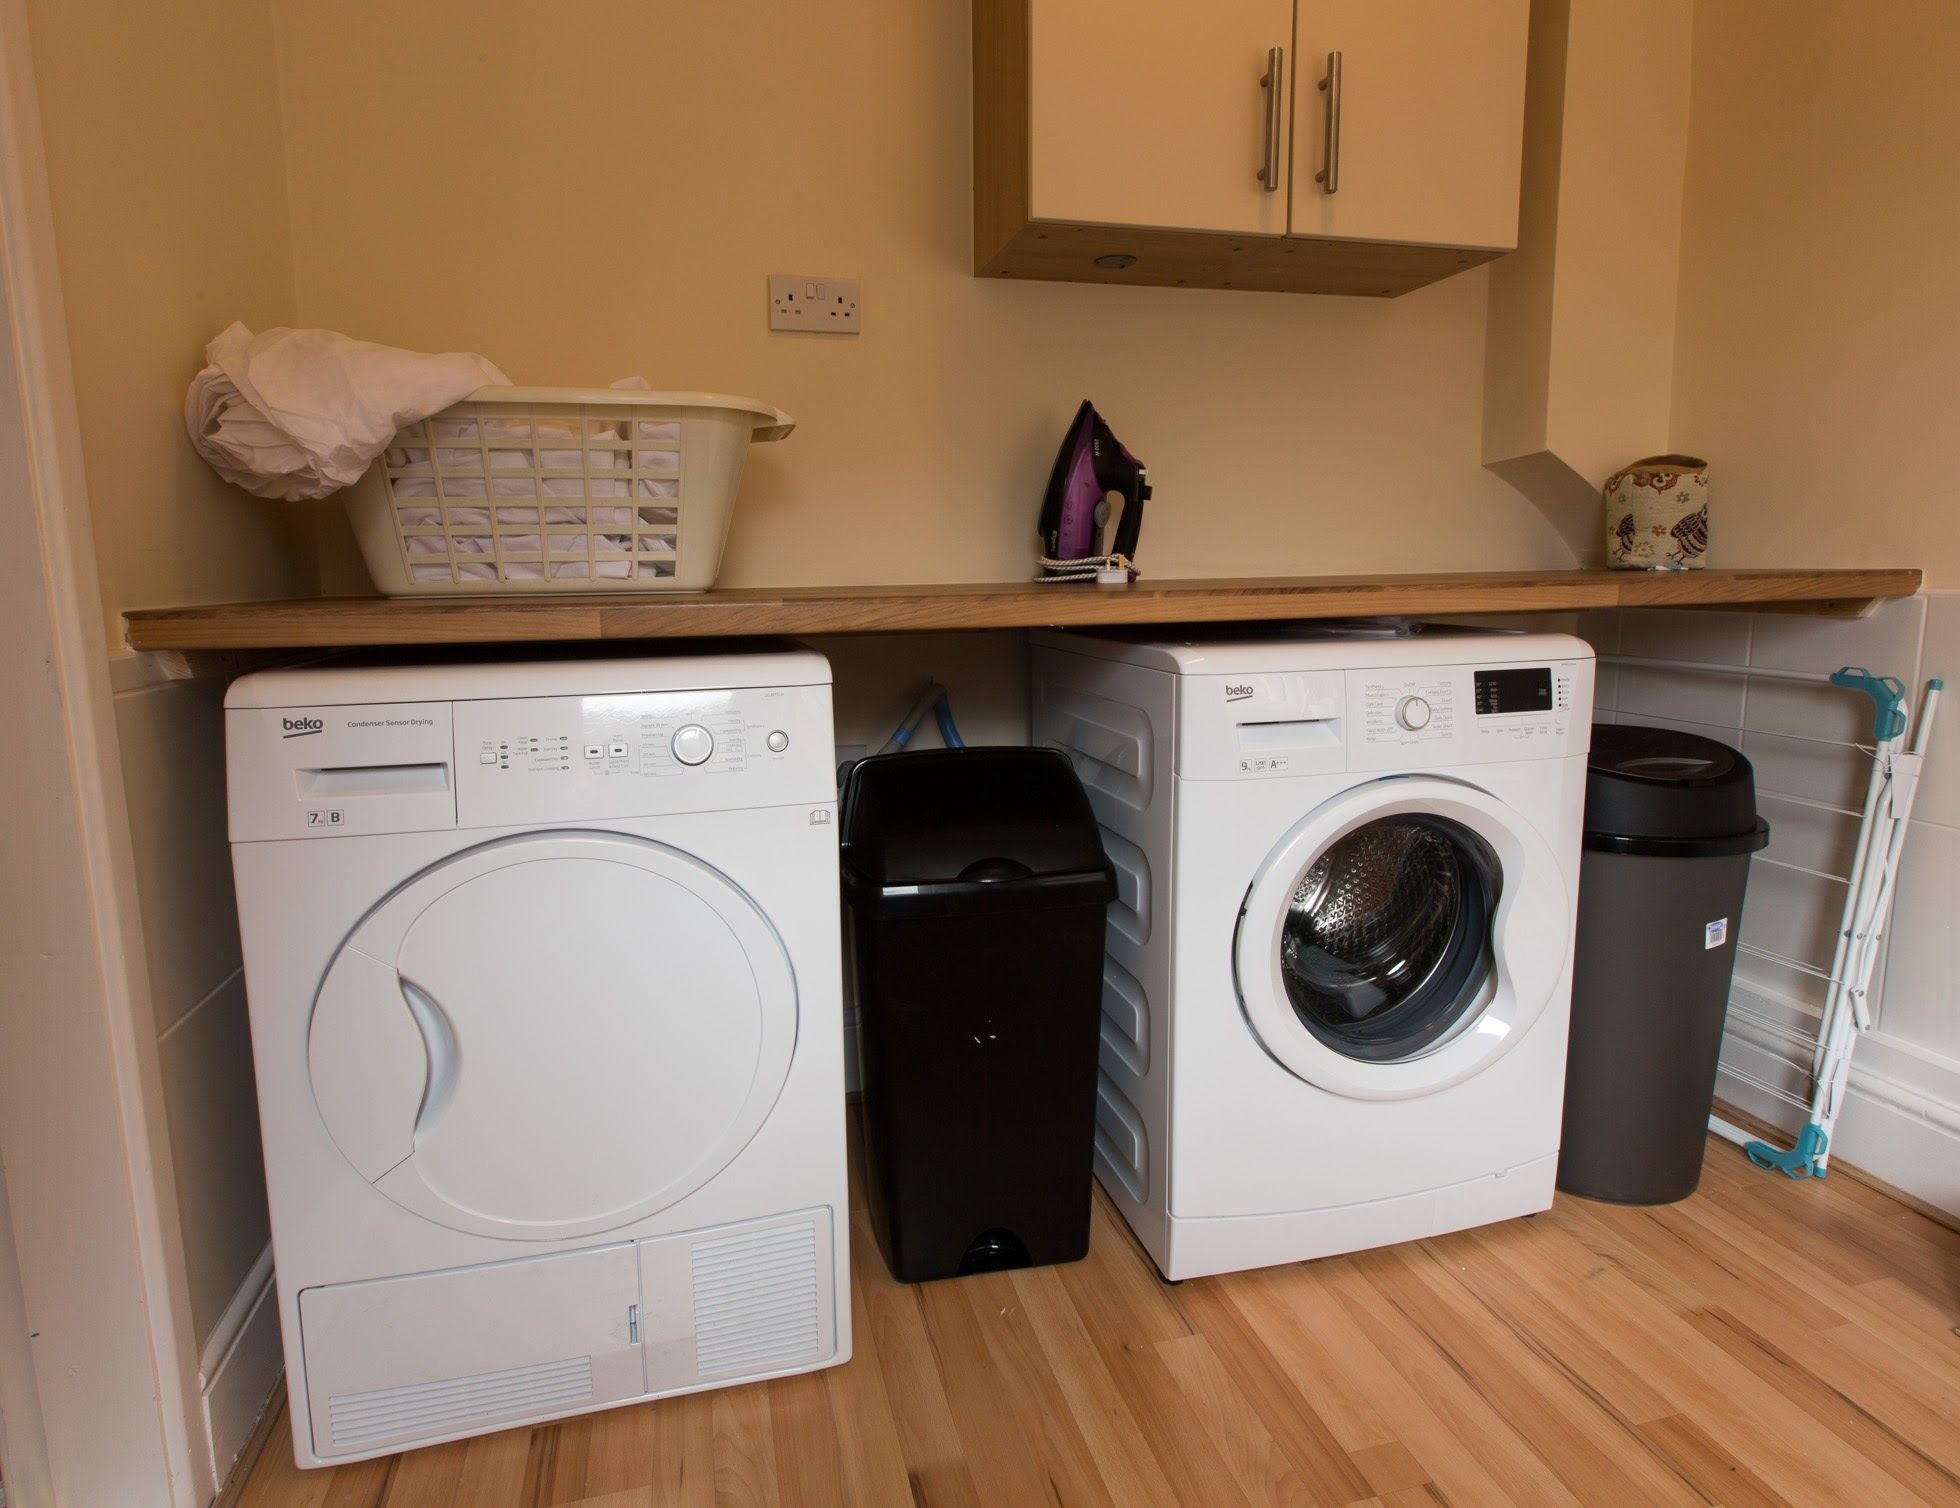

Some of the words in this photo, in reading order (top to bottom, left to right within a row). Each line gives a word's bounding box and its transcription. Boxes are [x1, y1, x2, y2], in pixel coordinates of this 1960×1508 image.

[1225, 685, 1254, 696] beko
[283, 717, 323, 731] beko
[347, 720, 384, 728] Condenser
[386, 719, 410, 727] Sensor
[1270, 759, 1287, 769] A+++
[330, 812, 341, 823] B
